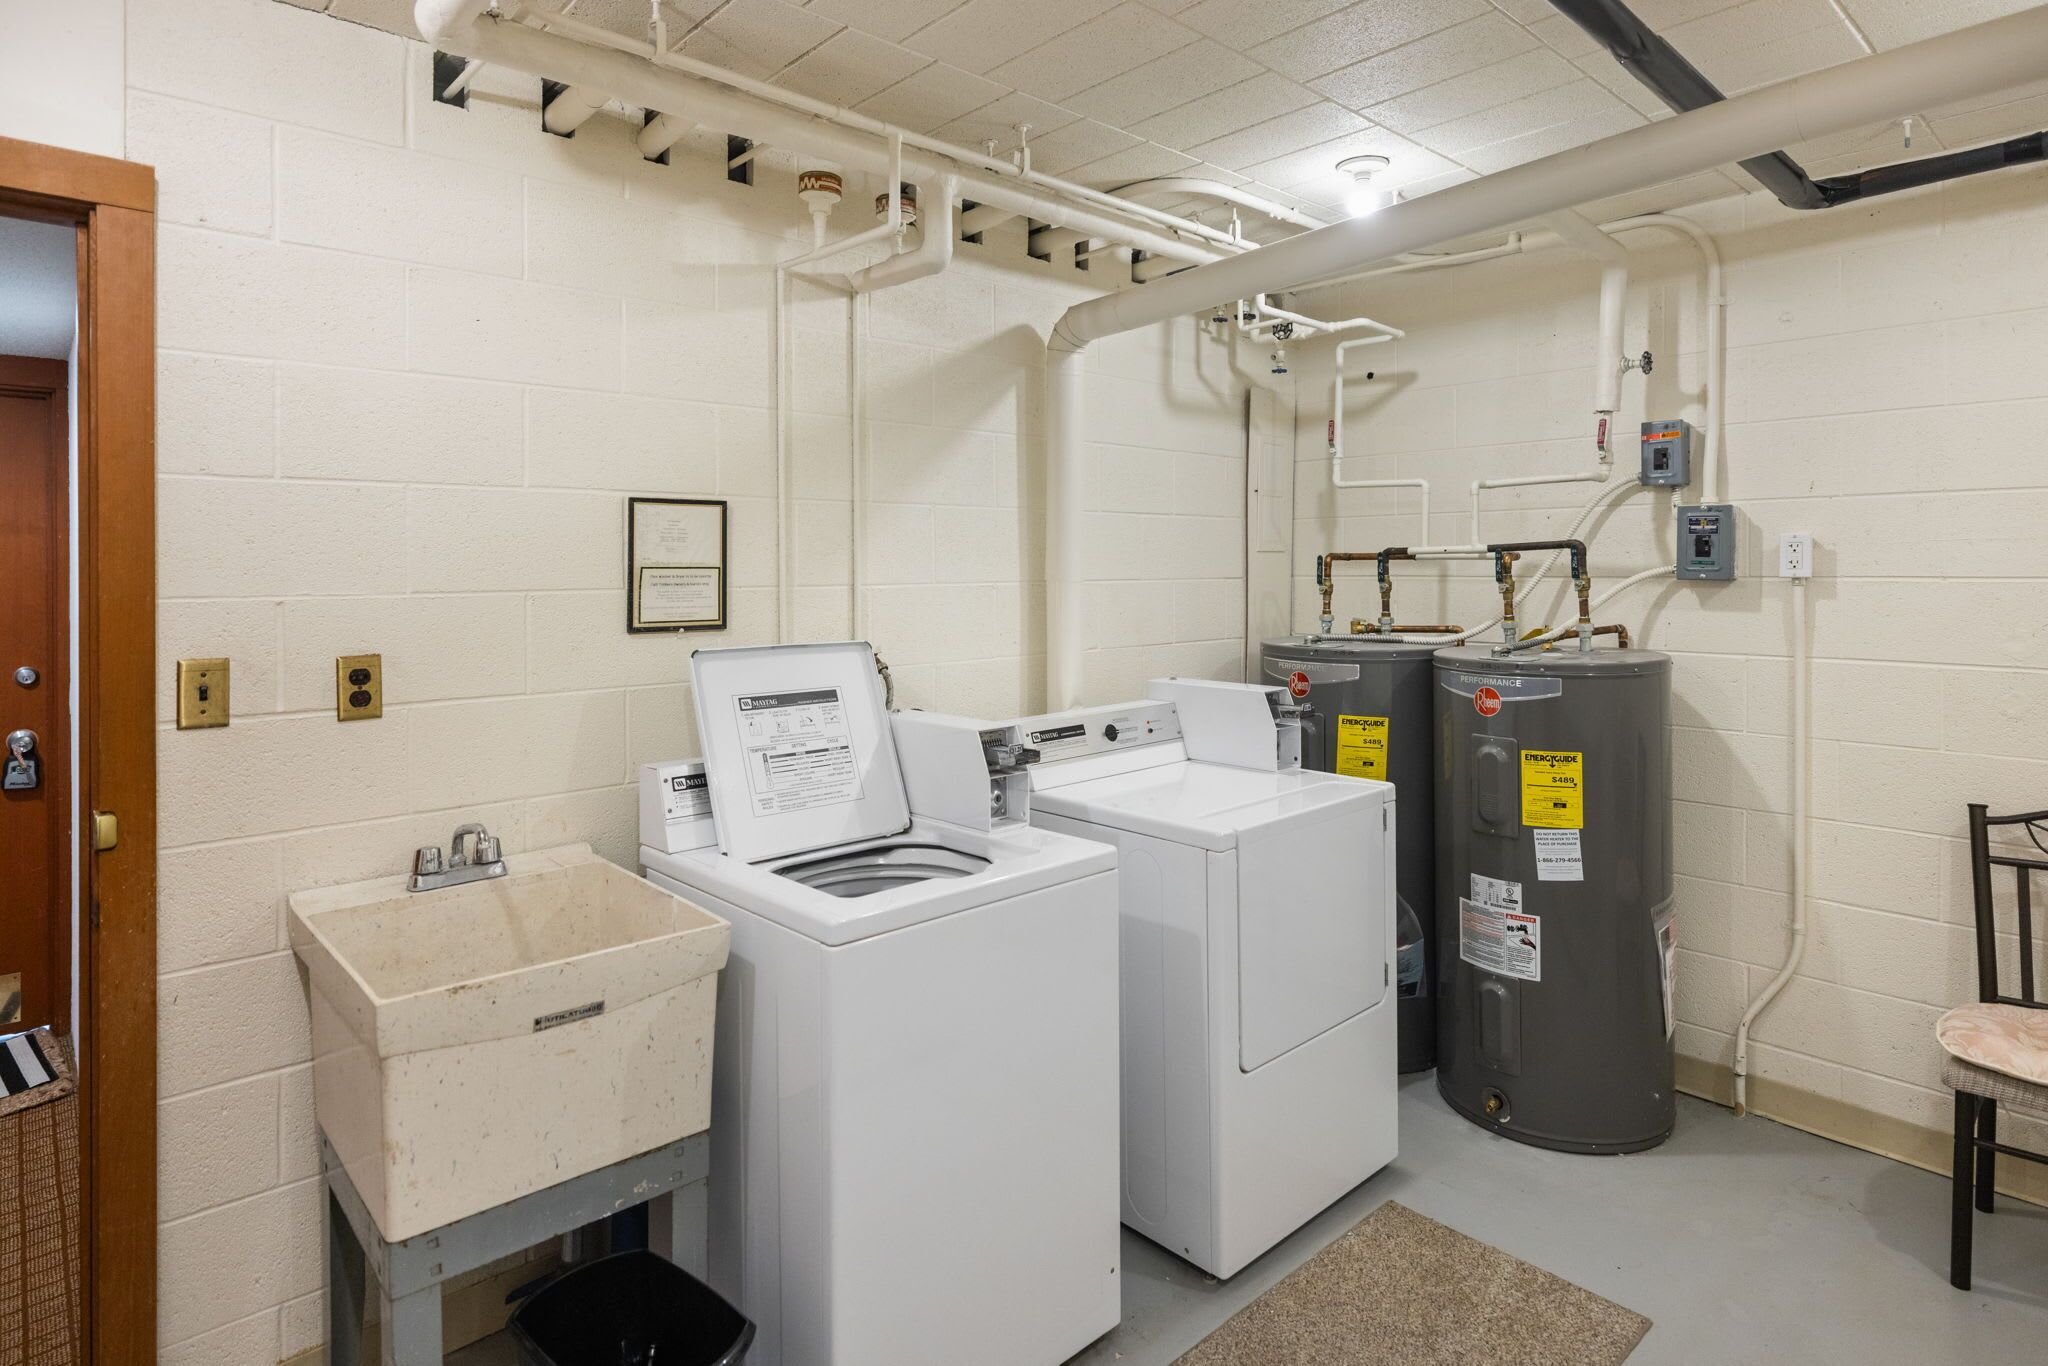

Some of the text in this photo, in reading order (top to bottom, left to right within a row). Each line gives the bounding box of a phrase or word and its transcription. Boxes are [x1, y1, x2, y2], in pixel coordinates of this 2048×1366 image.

[1278, 662, 1328, 672] PERFORMANCE
[1291, 672, 1309, 693] Rheem
[1460, 676, 1522, 687] PERFORMANCE
[752, 698, 778, 706] MAYTAG
[1476, 687, 1501, 711] Rheem
[1341, 718, 1386, 728] ENERGYGUIDE
[1040, 731, 1059, 740] MAYTAG
[1525, 753, 1579, 763] ENERGYGUIDE
[687, 777, 707, 786] MAYT
[1552, 776, 1575, 784] $489
